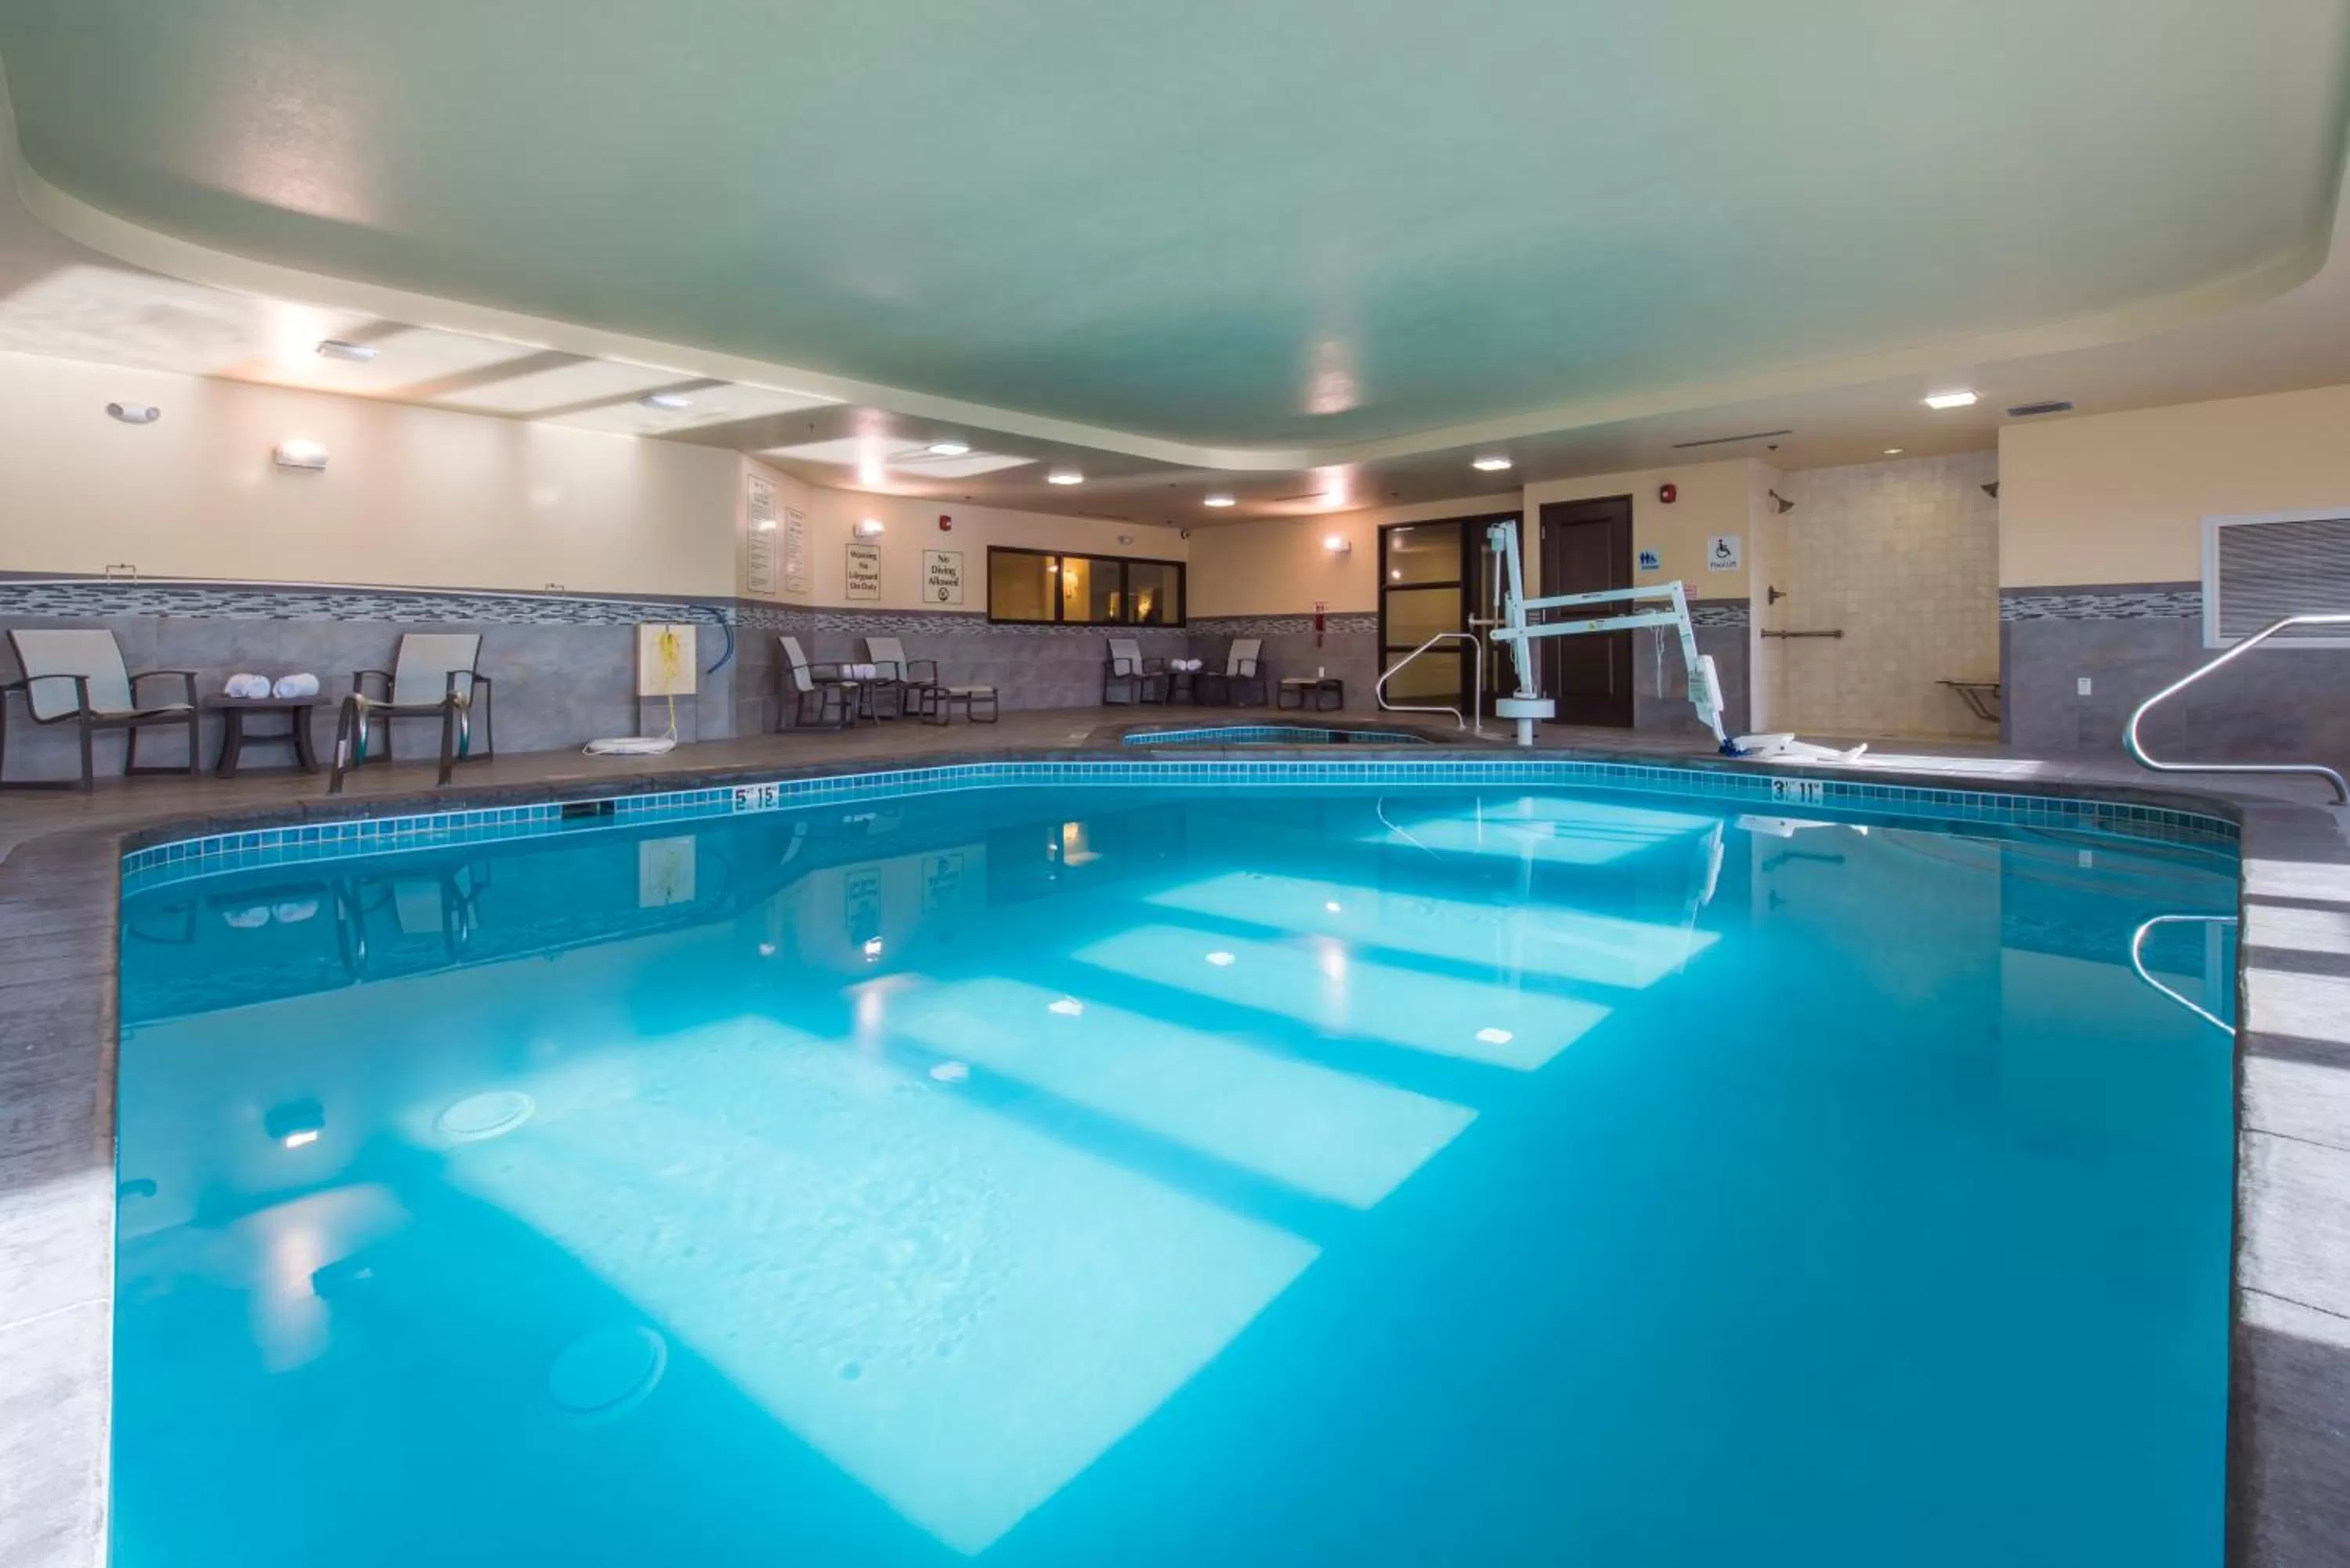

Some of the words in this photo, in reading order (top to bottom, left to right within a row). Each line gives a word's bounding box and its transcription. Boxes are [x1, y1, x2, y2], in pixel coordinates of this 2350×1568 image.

[938, 555, 949, 563] No
[931, 565, 956, 576] Diving
[928, 576, 959, 586] Allowed
